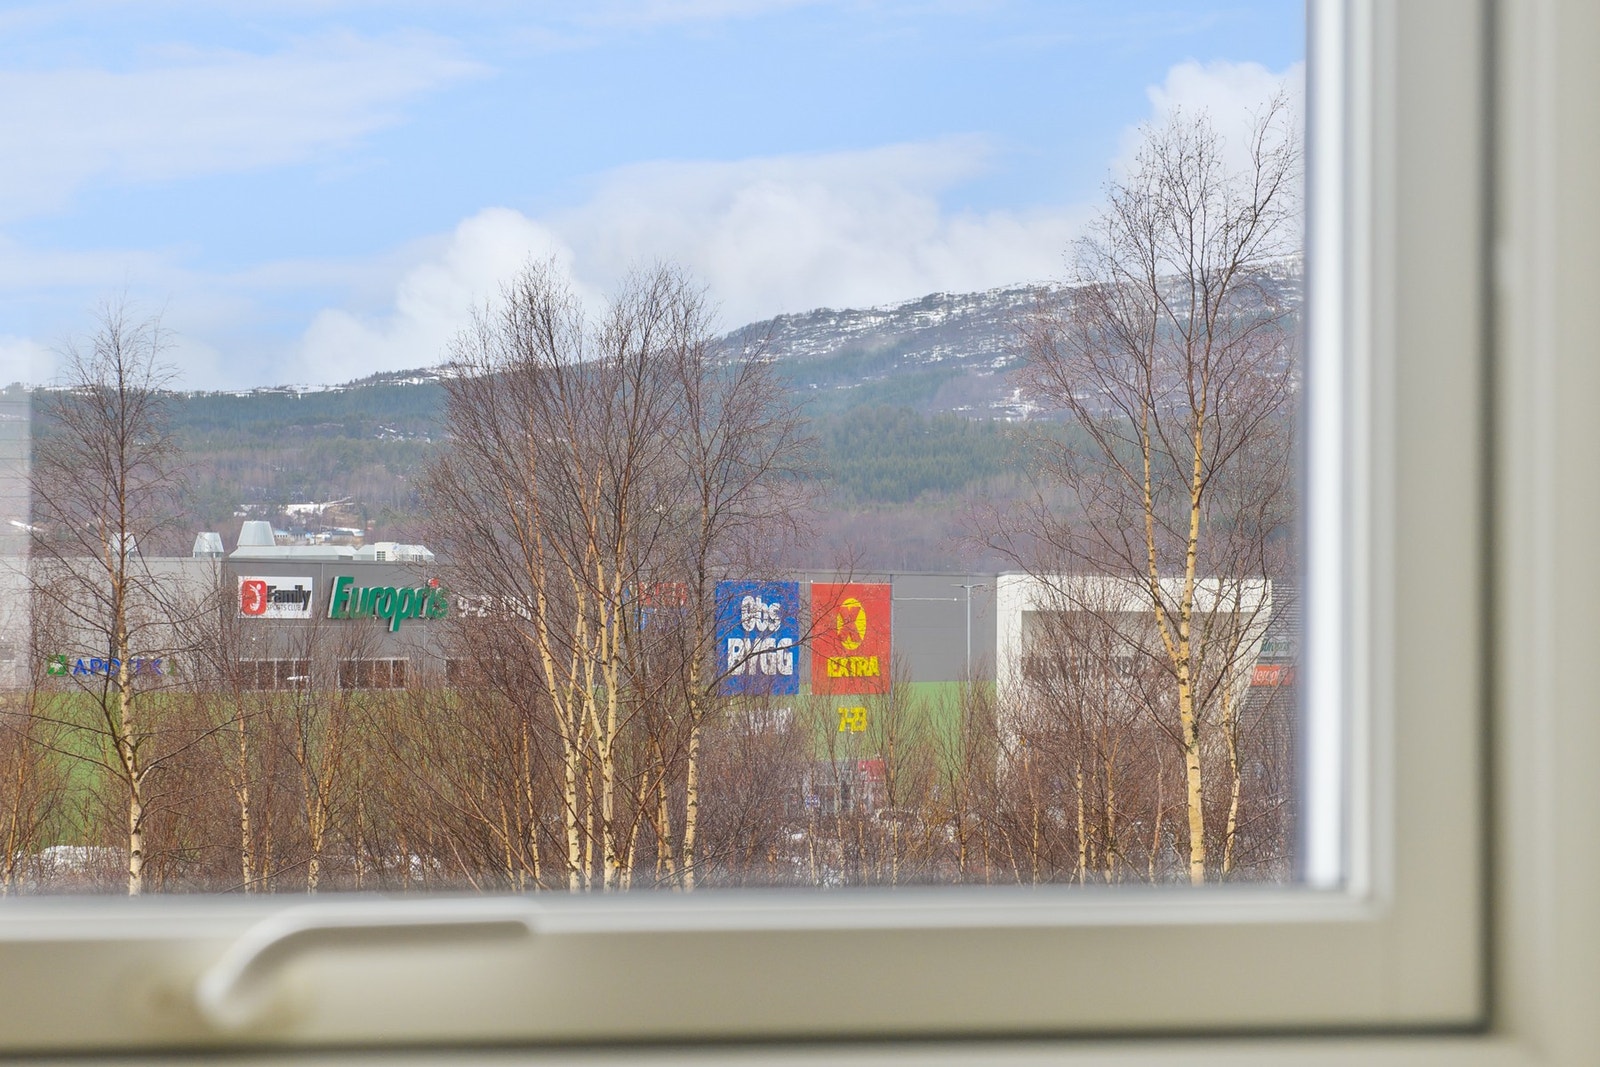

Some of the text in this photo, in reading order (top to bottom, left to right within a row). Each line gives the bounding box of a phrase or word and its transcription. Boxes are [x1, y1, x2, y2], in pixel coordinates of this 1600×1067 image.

[266, 585, 312, 611] Family
[327, 576, 449, 632] Europris
[741, 595, 781, 632] Obs
[727, 637, 794, 676] BYGG
[827, 655, 881, 678] EXTRA
